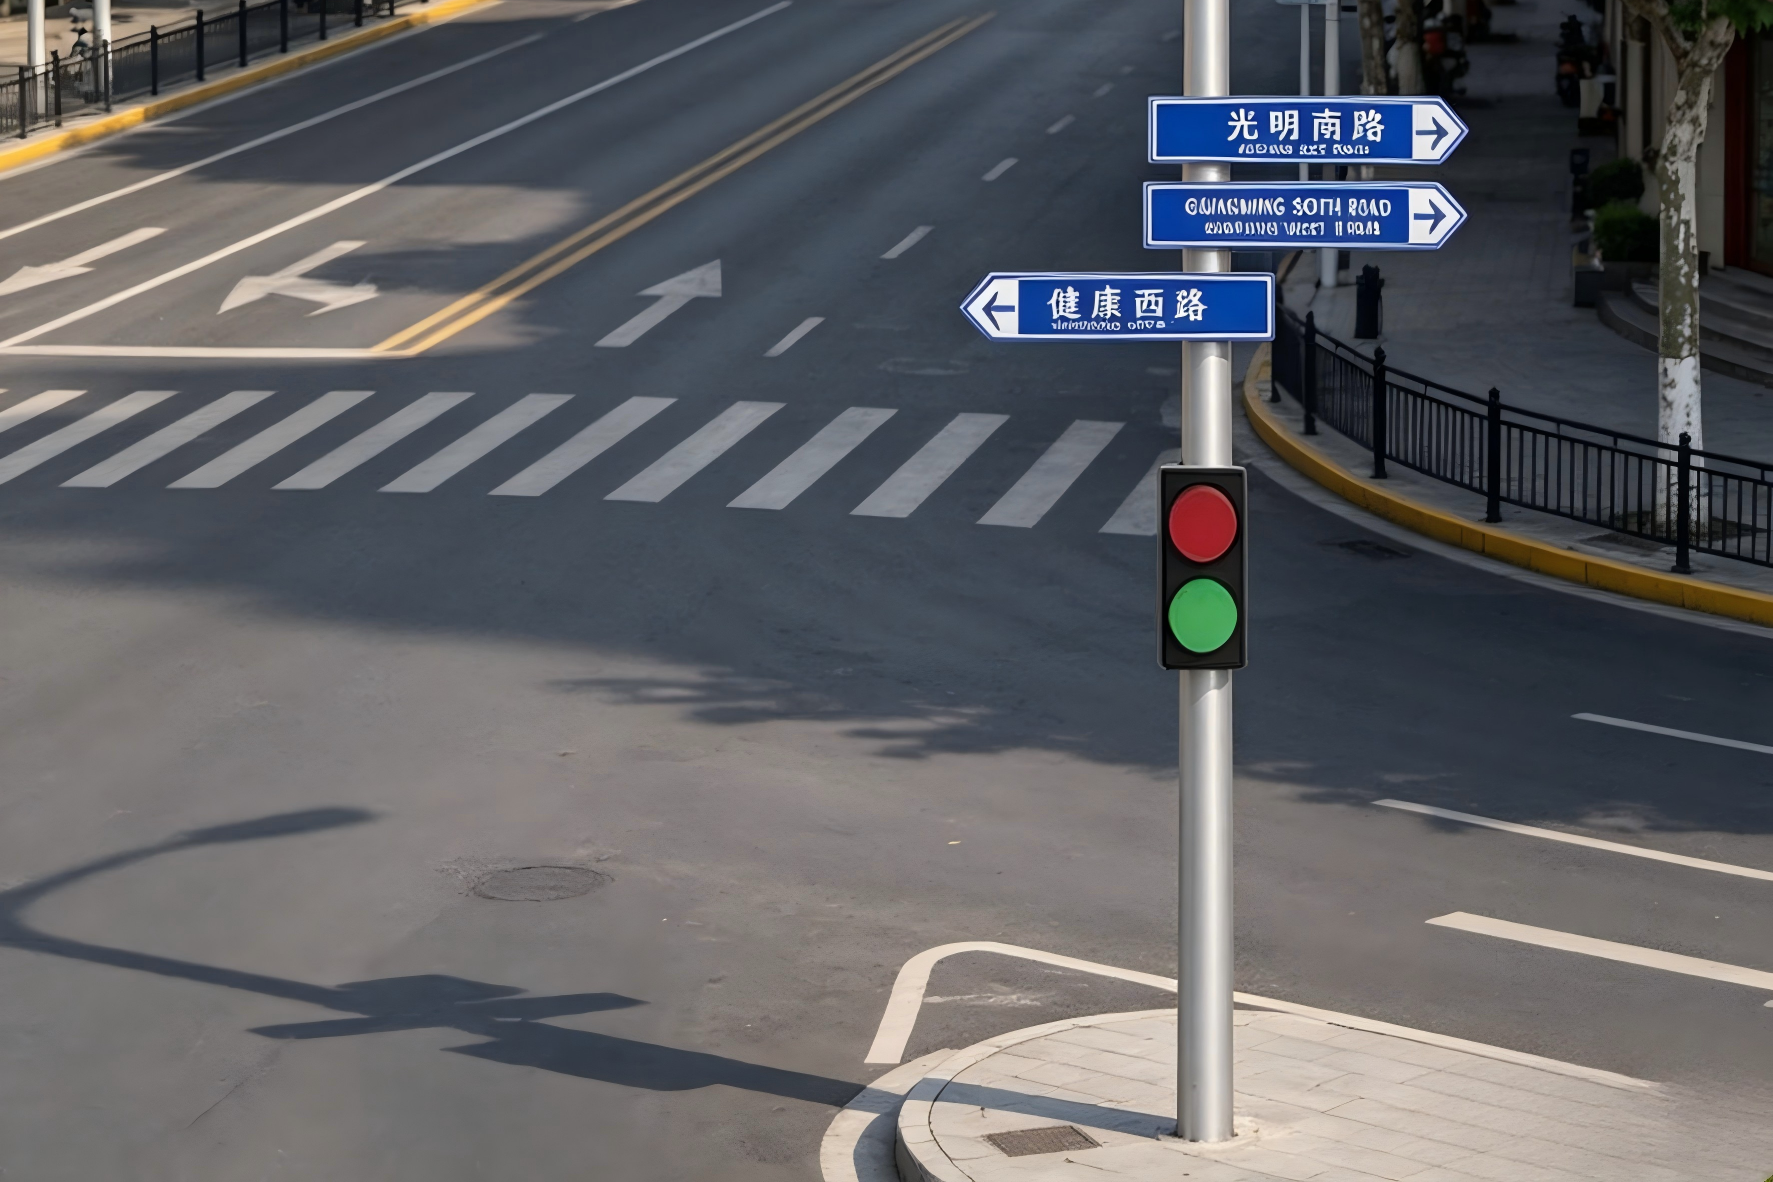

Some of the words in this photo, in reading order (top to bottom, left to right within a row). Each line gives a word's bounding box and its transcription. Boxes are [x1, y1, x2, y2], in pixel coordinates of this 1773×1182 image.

[1227, 108, 1385, 142] 光明南路
[1047, 284, 1208, 321] 健康西路
